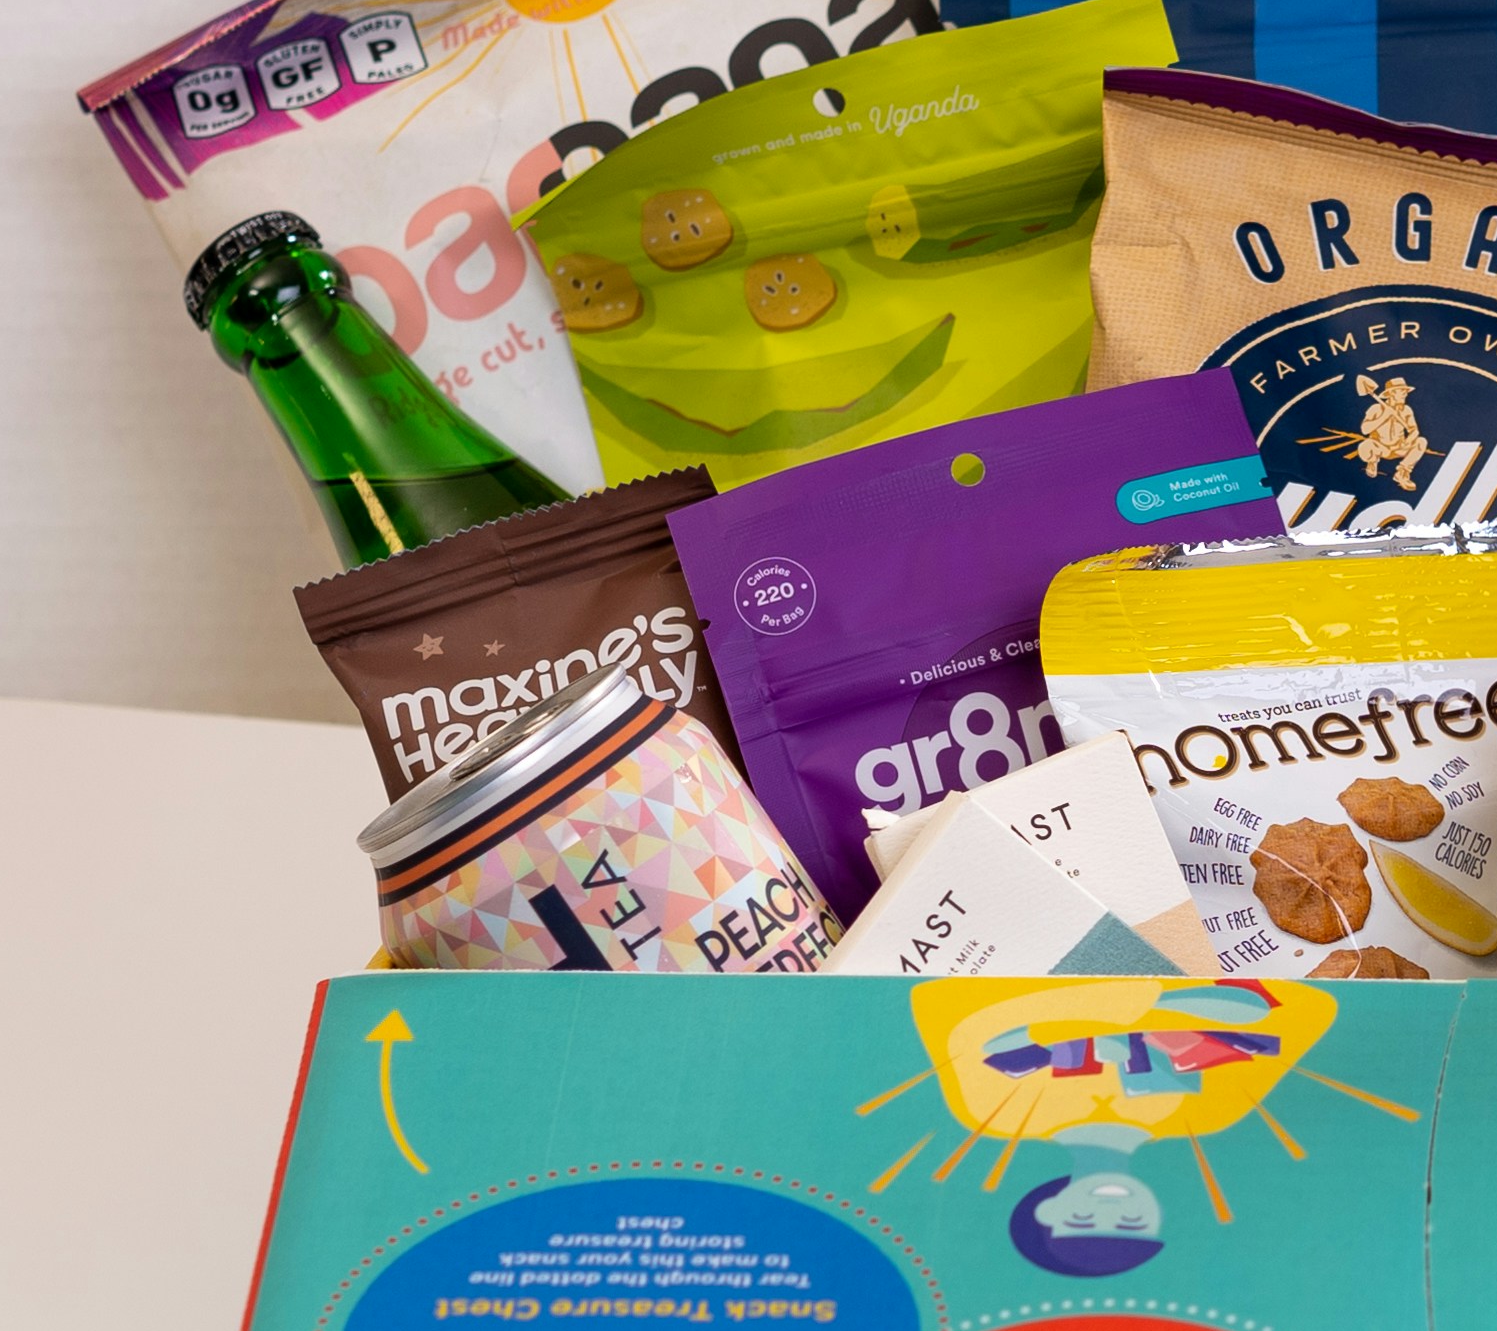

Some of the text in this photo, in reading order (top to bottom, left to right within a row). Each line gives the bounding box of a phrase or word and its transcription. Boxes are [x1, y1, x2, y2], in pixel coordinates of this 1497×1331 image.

[349, 20, 403, 40] SIMPLY
[442, 14, 521, 51] Made
[264, 44, 320, 68] GLUTEN
[368, 39, 397, 63] P
[271, 57, 323, 88] GF
[187, 89, 240, 113] 0g
[286, 87, 325, 105] FREE
[712, 85, 979, 164] grown and made in Uganda
[481, 322, 545, 372] cut,
[1250, 321, 1422, 394] FARMER
[1169, 473, 1228, 491] Made with
[1173, 482, 1240, 502] Coconut Oil
[747, 564, 791, 588] Calories
[754, 582, 795, 607] 220
[760, 605, 804, 627] Per Bag
[381, 606, 695, 740] maxine's
[910, 648, 1003, 686] Delicious &
[1217, 688, 1363, 724] treats you can trust
[1429, 756, 1470, 791] NO CORN
[1445, 781, 1485, 810] NO SOY
[1214, 797, 1262, 831] EGG FREE
[1189, 826, 1251, 854] DAIRY FREE
[1442, 821, 1492, 857] JUST 150
[1213, 864, 1244, 885] FREE
[1435, 843, 1487, 879] CALORIES
[582, 848, 662, 960] TEA
[694, 862, 815, 973] PEACH
[1226, 907, 1258, 928] FREE
[956, 938, 980, 966] Milk
[1236, 930, 1279, 961] FREE
[616, 1215, 686, 1232] chest
[549, 1232, 747, 1251] storing treasure
[499, 1250, 791, 1270] to make this your snack
[469, 1269, 811, 1289] Tear through the dotted line
[434, 1297, 838, 1323] Snack Treasure Chest
